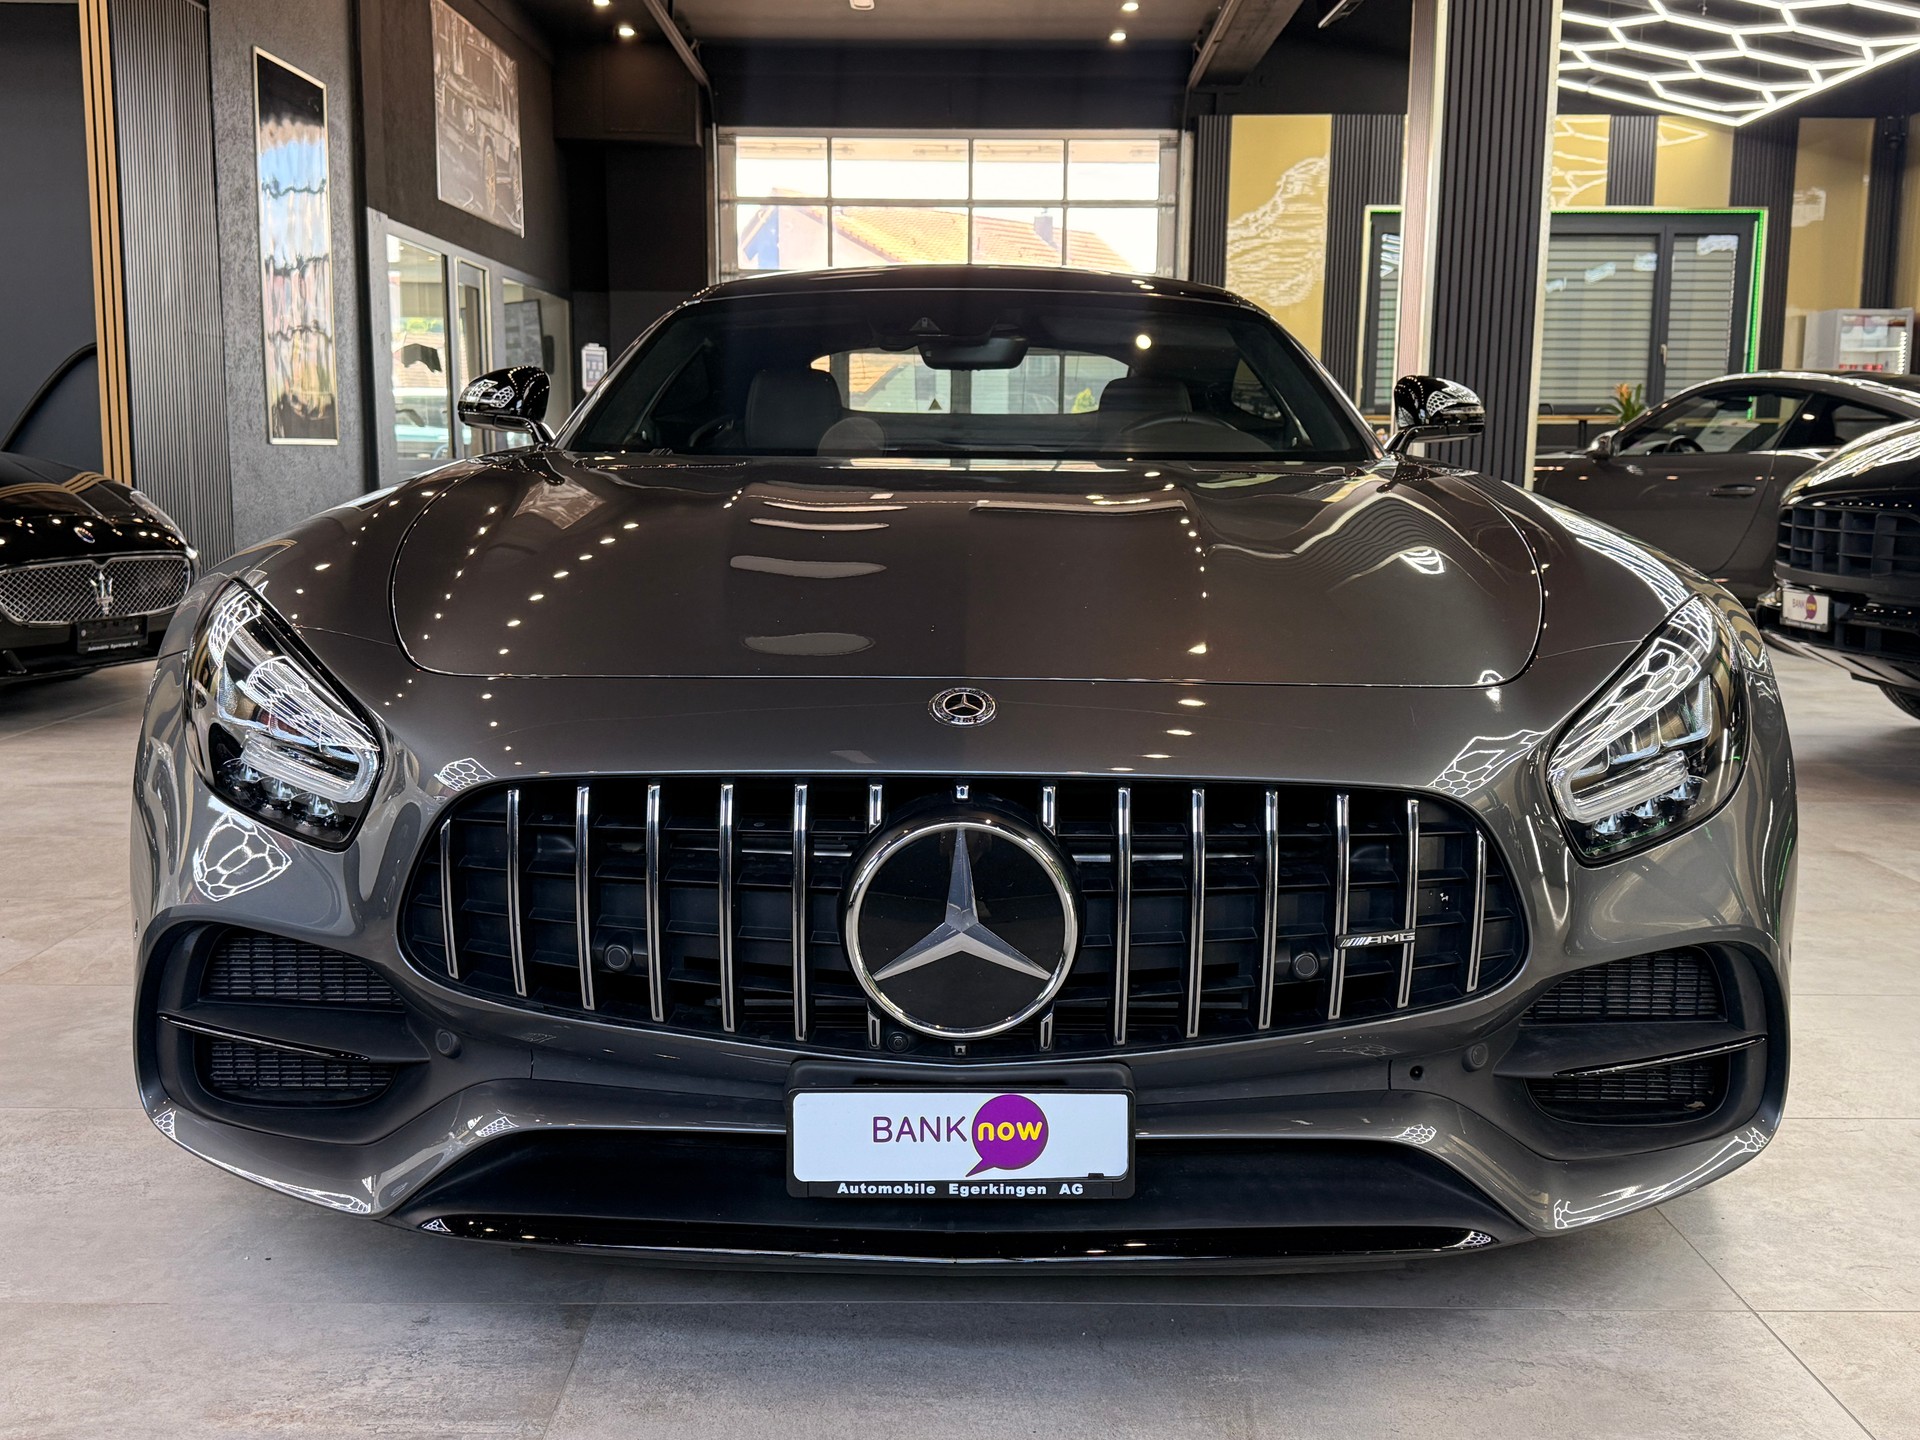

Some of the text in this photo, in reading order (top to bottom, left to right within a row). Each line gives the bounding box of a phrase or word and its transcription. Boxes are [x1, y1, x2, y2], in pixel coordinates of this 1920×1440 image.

[1364, 932, 1415, 945] AMG
[873, 1116, 1042, 1142] BANK now
[837, 1182, 1084, 1197] Automobile Egerkingen AG
